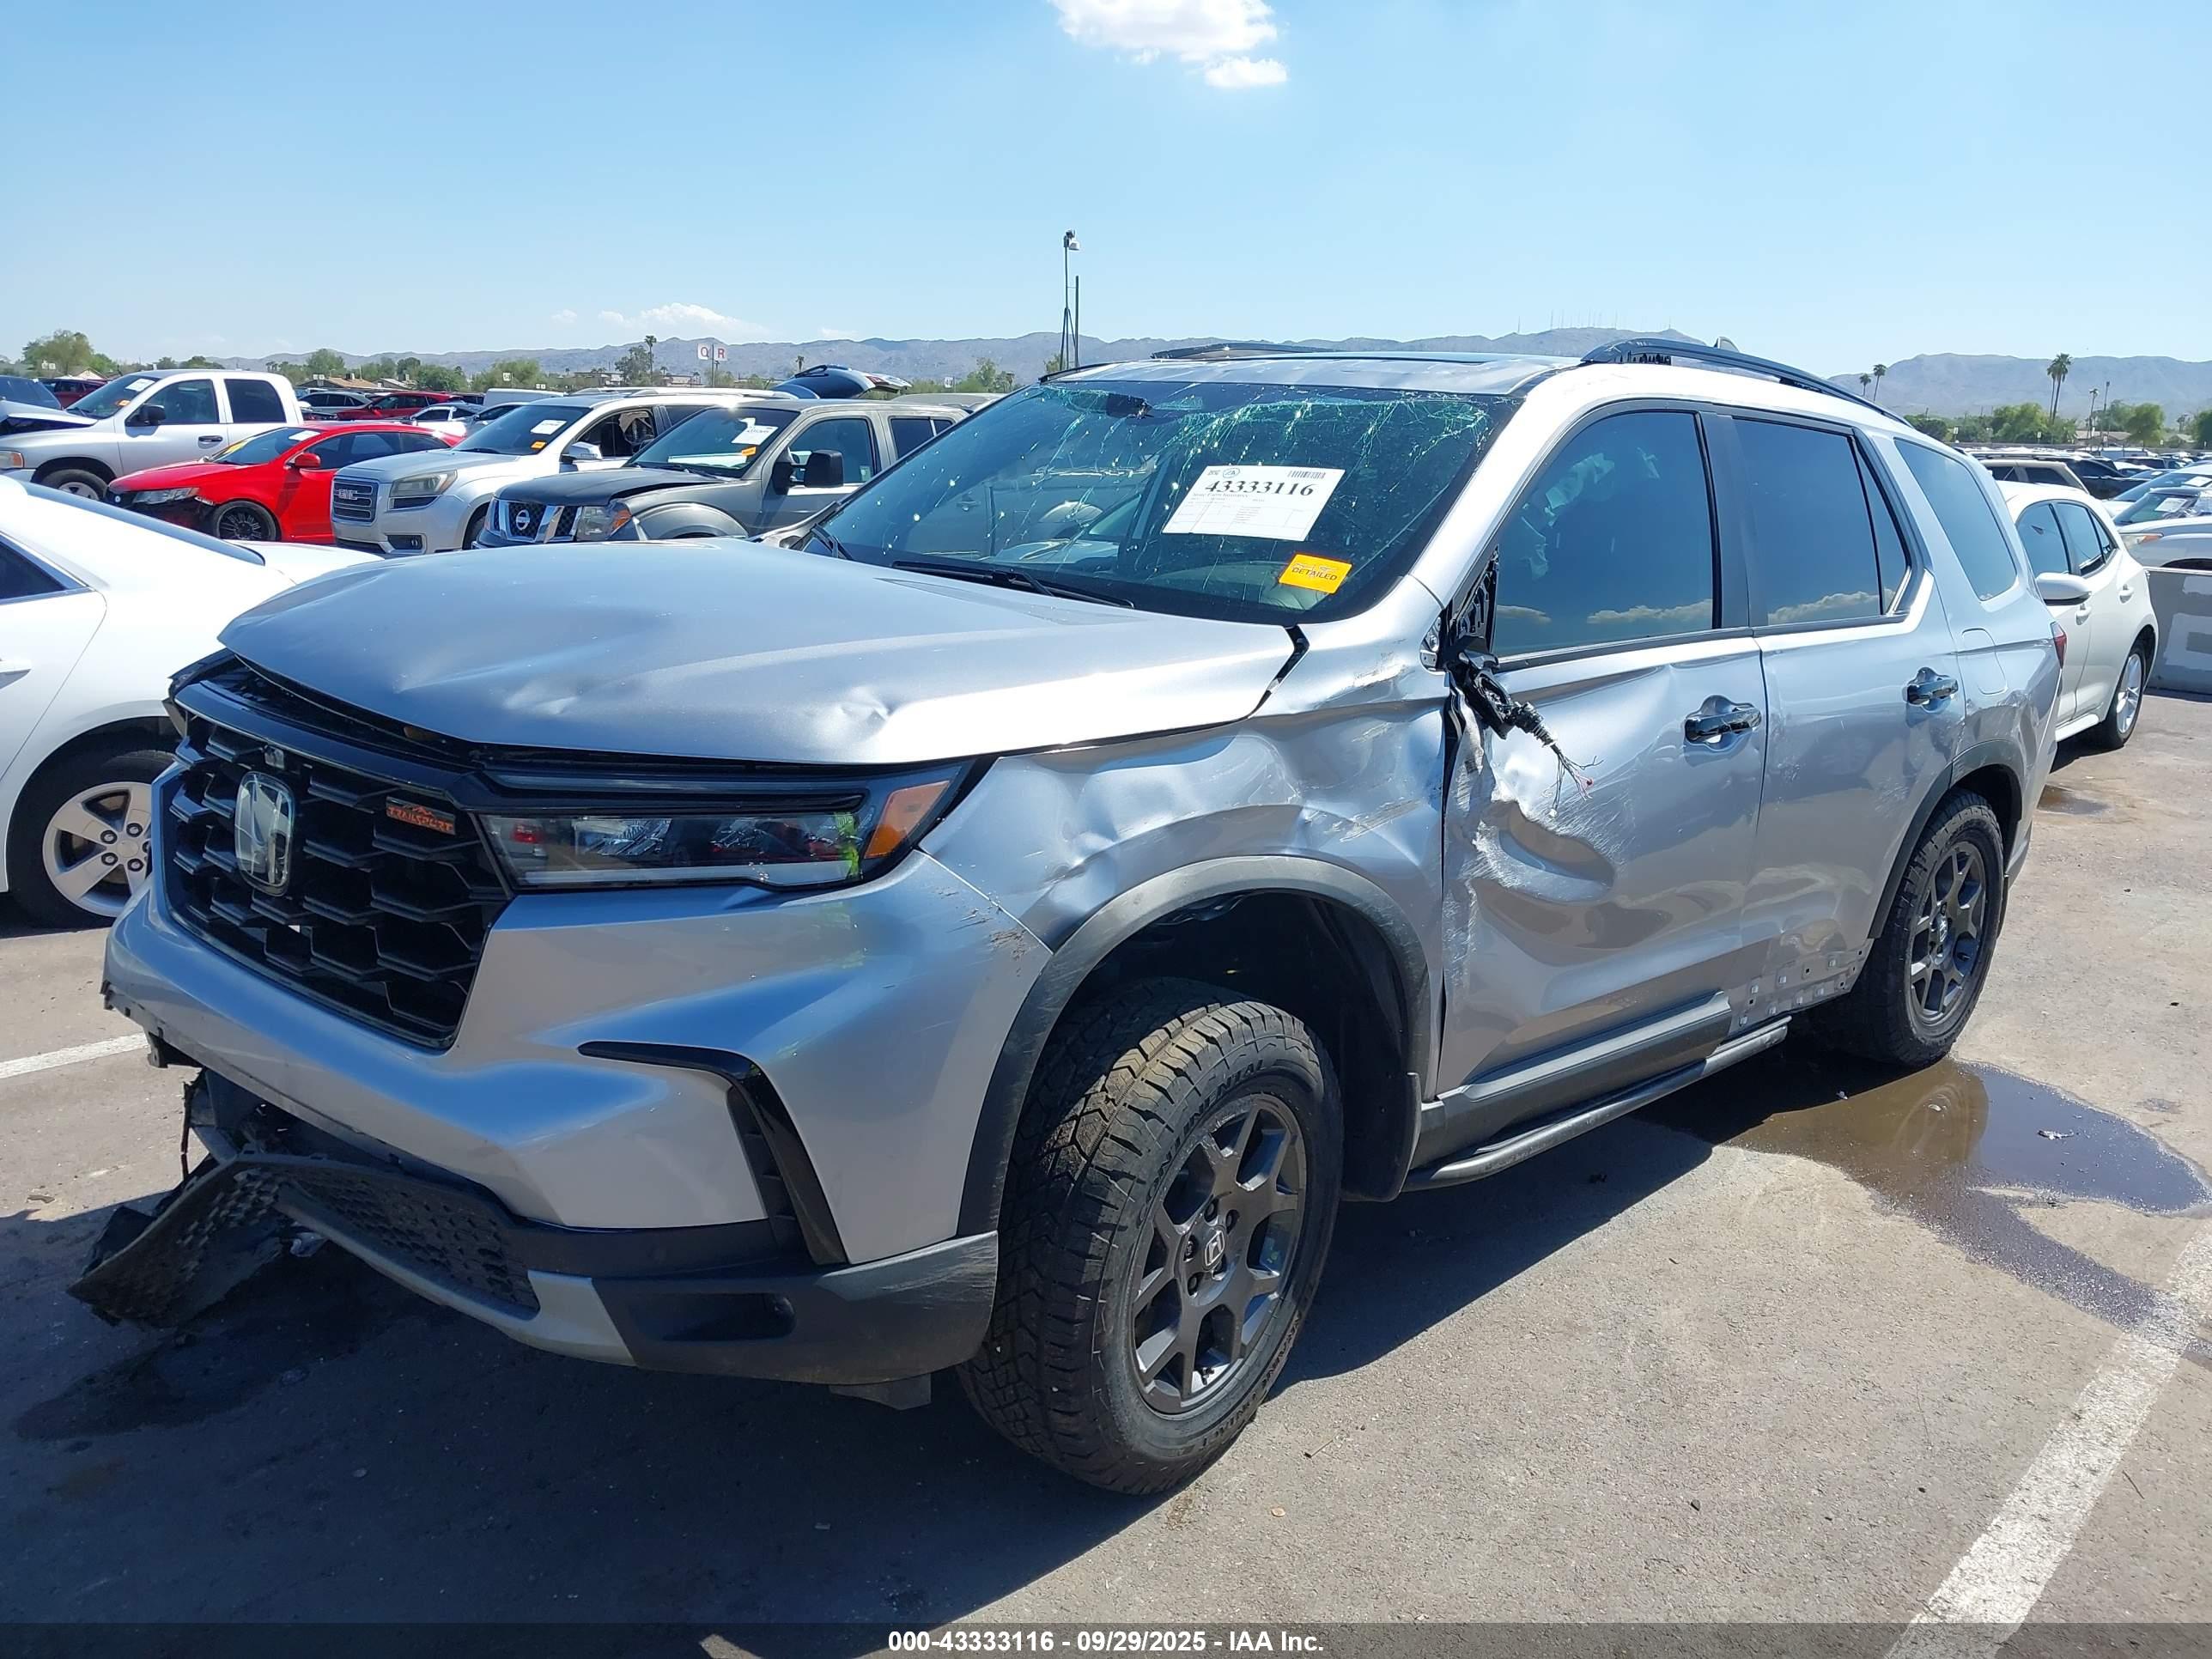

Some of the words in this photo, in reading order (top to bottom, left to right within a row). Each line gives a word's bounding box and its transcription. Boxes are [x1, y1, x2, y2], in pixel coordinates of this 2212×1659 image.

[701, 346, 709, 357] Q
[717, 348, 725, 359] R
[1205, 480, 1320, 496] 43333116
[1291, 567, 1338, 581] DETAILED
[388, 805, 453, 831] TRAILSPORT
